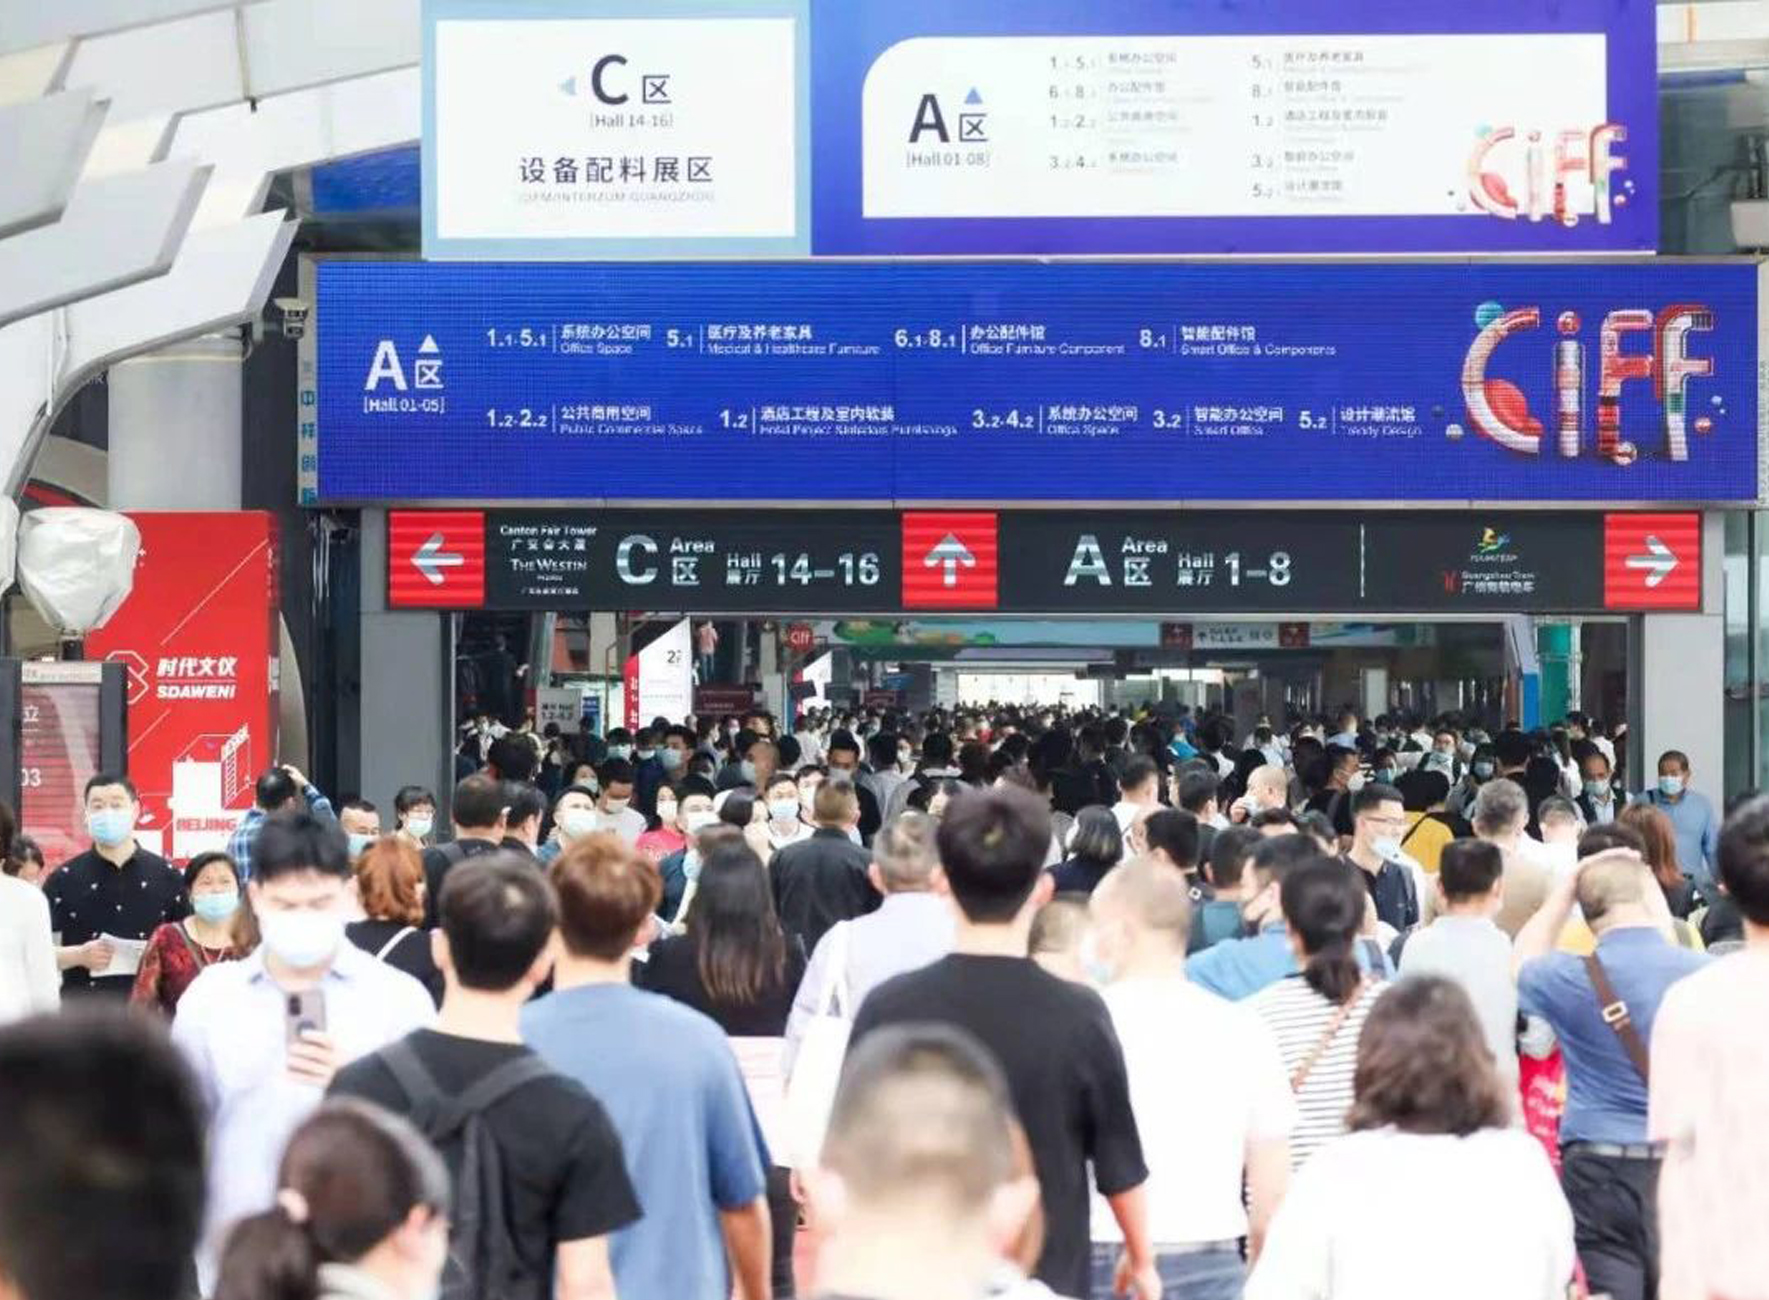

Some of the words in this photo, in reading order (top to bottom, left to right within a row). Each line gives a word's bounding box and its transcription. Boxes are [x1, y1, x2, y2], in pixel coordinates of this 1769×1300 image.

[591, 53, 629, 105] C
[642, 74, 672, 104] 区
[908, 93, 950, 143] A
[959, 113, 989, 142] 区
[519, 156, 713, 184] 设备配料展区
[561, 324, 651, 341] 系统办公空间
[667, 328, 693, 348] 5.1
[708, 324, 812, 341] 医疗及养老家具
[970, 324, 1046, 341] 办公配件馆
[1139, 328, 1166, 348] 8.1
[597, 342, 632, 355] Space
[364, 340, 408, 391] A
[415, 359, 444, 388] 区
[719, 408, 748, 428] 1.2
[1047, 405, 1139, 422] 系统办公空间
[1153, 410, 1181, 429] 3.2
[1194, 405, 1283, 422] 智能办公空间
[1299, 410, 1328, 429] 5.2
[500, 524, 538, 536] Canton
[564, 525, 598, 536] Tower
[670, 537, 715, 554] Area
[1121, 536, 1168, 554] Area
[617, 534, 658, 585] C
[727, 552, 761, 568] Hall
[1063, 534, 1112, 586] A
[1178, 553, 1214, 569] Hall
[672, 557, 700, 586] 区
[727, 569, 761, 585] 展厅
[1124, 557, 1153, 586] 区
[1177, 570, 1214, 586] 展厅
